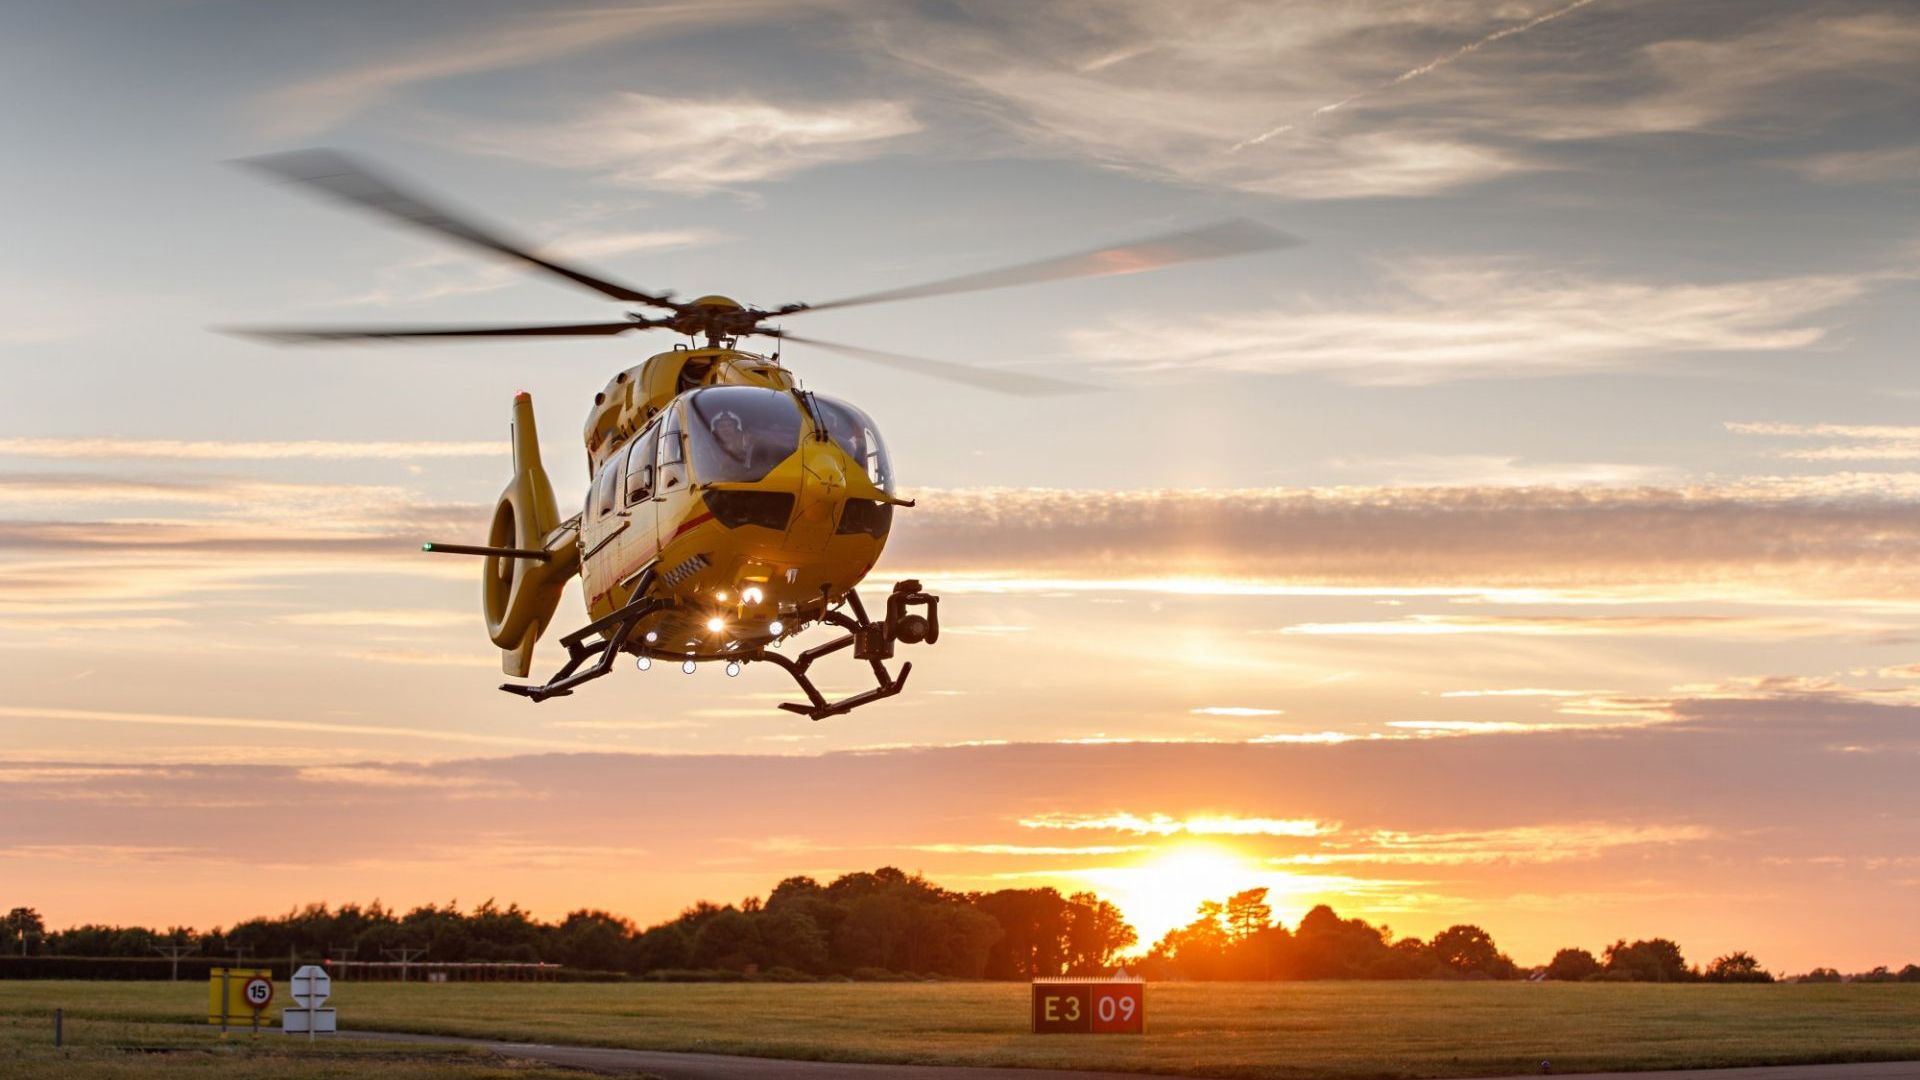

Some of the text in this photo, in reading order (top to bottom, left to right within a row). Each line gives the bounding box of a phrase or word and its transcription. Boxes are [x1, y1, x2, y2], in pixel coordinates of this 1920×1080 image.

[250, 985, 267, 999] 15
[1045, 996, 1136, 1022] E3 09
